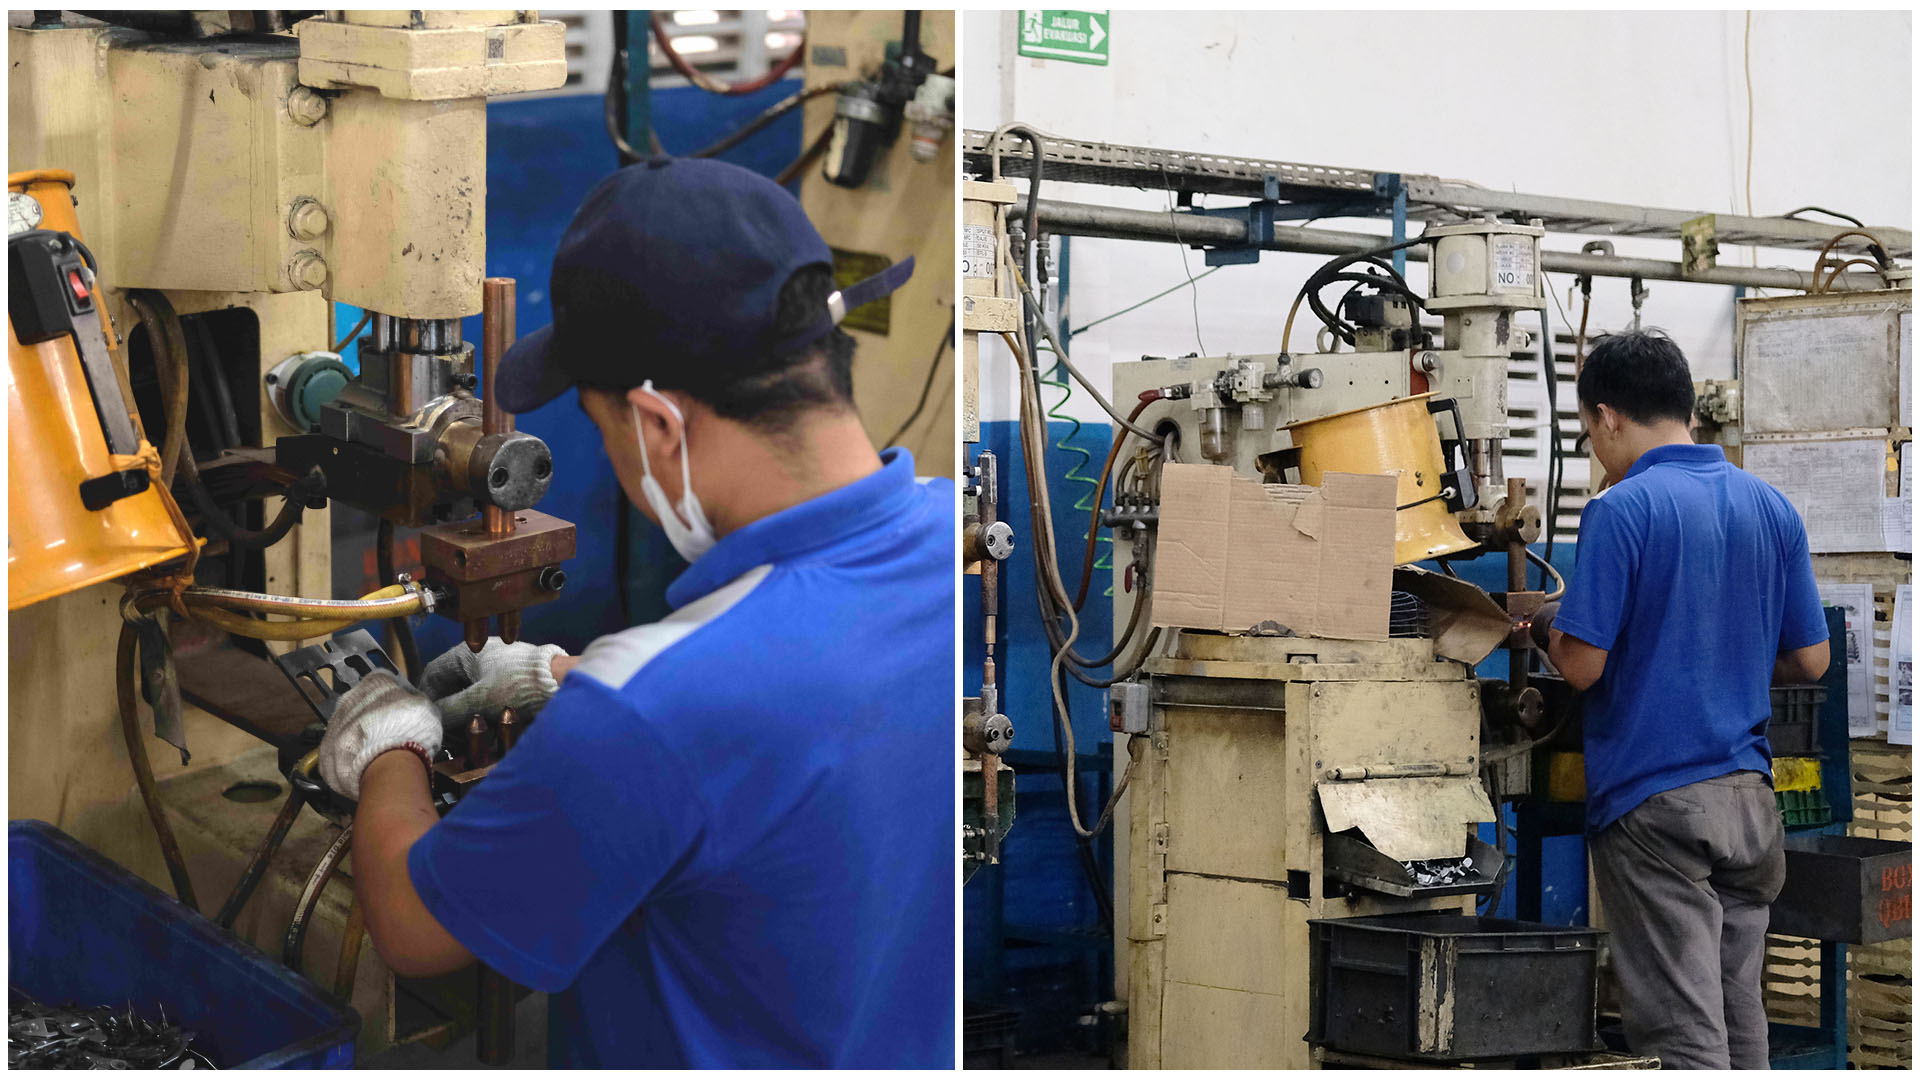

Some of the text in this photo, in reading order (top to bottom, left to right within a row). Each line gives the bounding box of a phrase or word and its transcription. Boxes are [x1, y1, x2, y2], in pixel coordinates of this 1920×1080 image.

[1051, 16, 1080, 29] JALUR
[1043, 28, 1087, 43] EVAKUASI
[1498, 272, 1515, 284] NO
